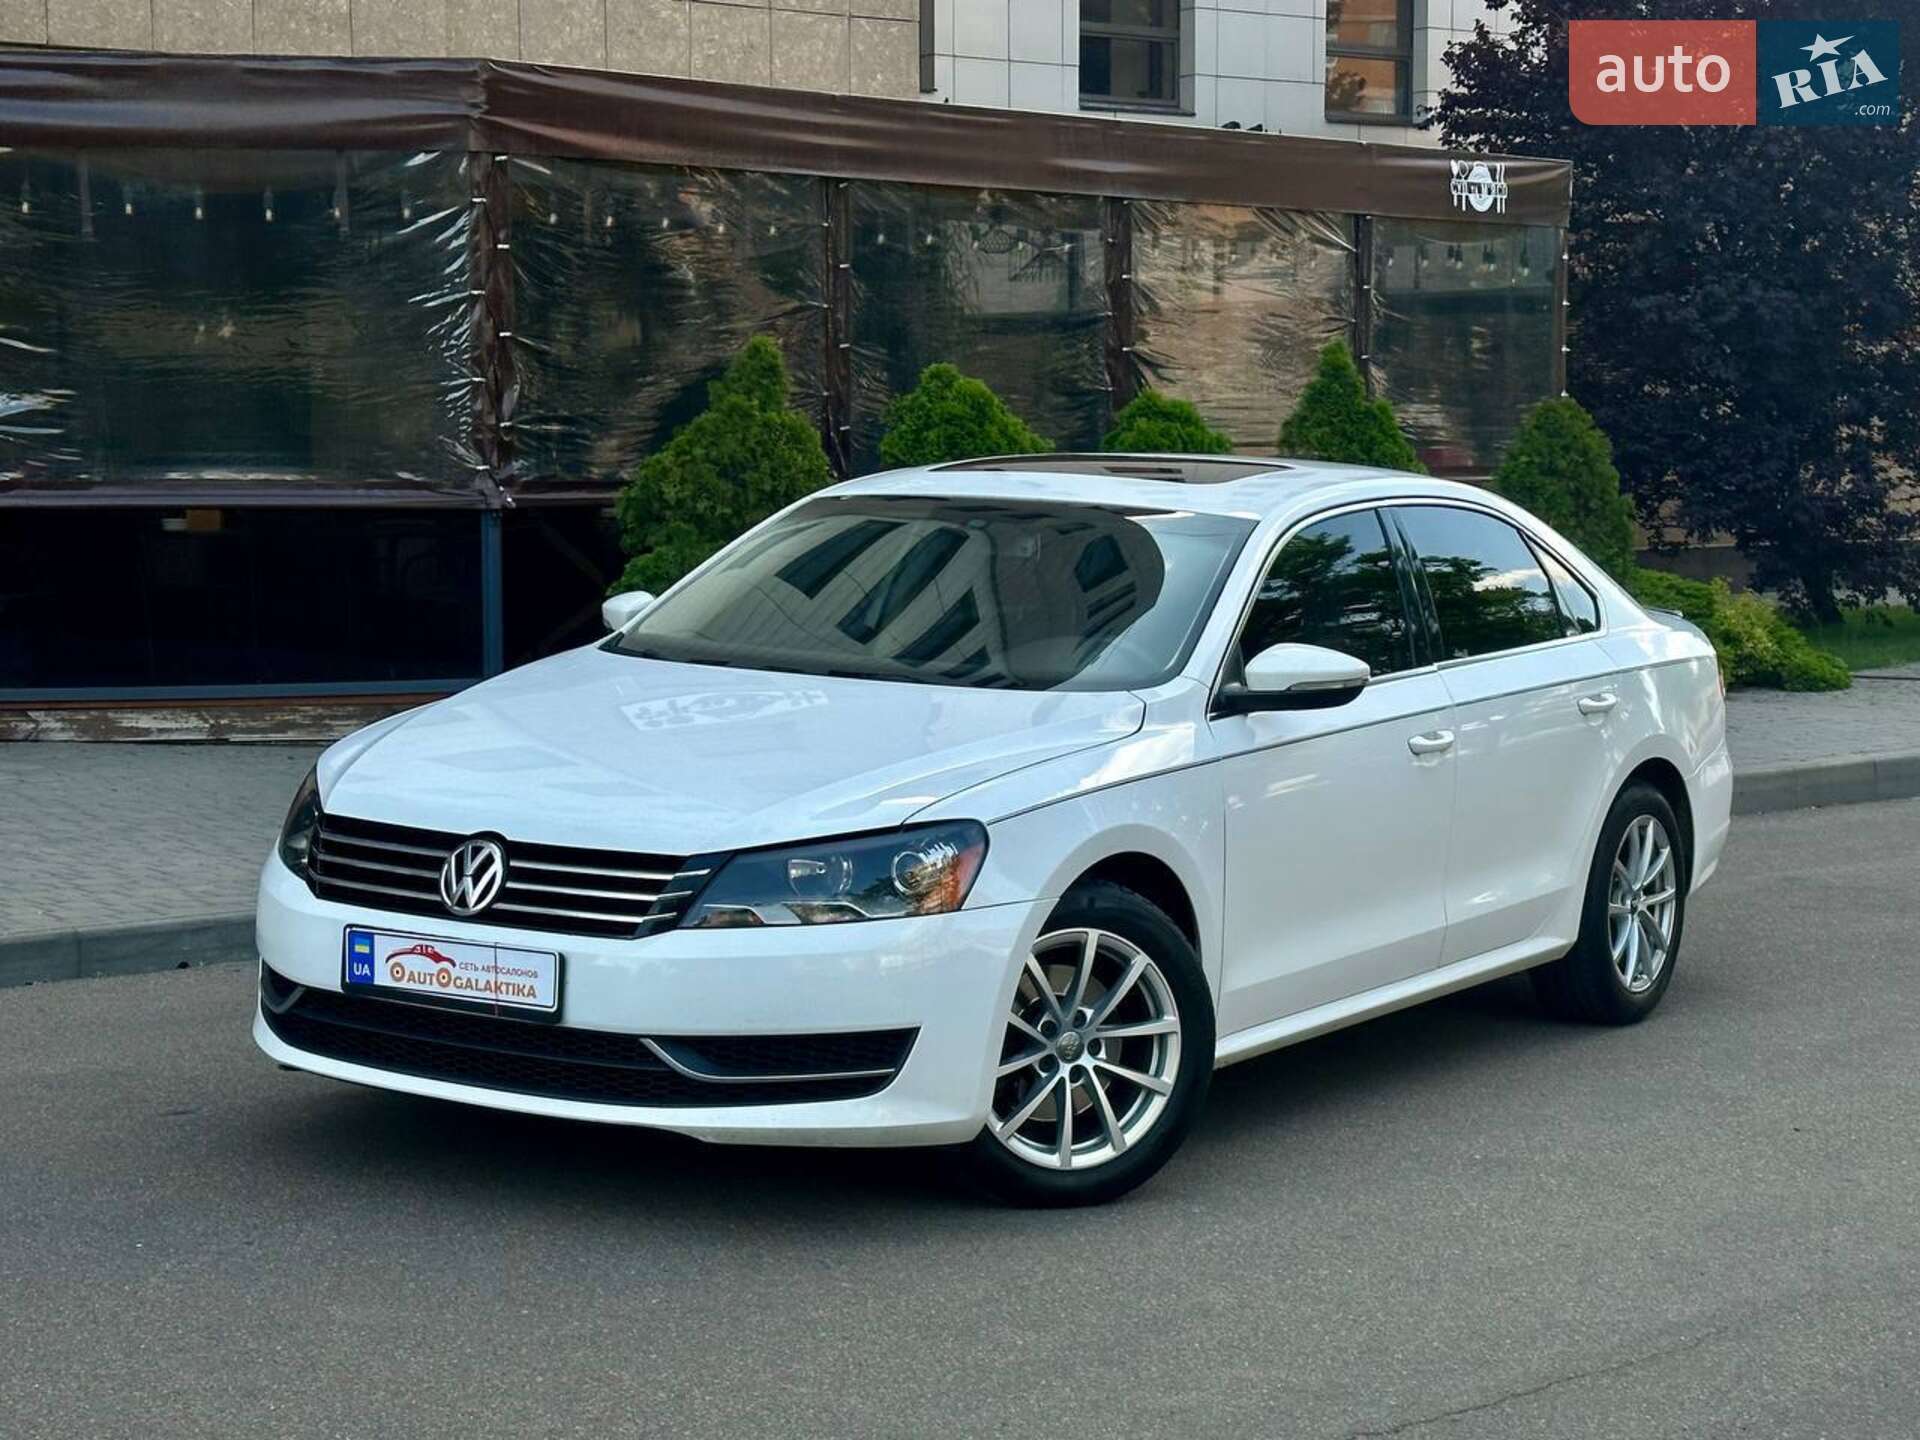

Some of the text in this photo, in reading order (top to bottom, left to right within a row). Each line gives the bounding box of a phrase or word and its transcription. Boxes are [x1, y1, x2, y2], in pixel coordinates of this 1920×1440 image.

[353, 962, 371, 977] UA
[459, 961, 538, 979] СЕТЬ АВТОСАЛОНОВ
